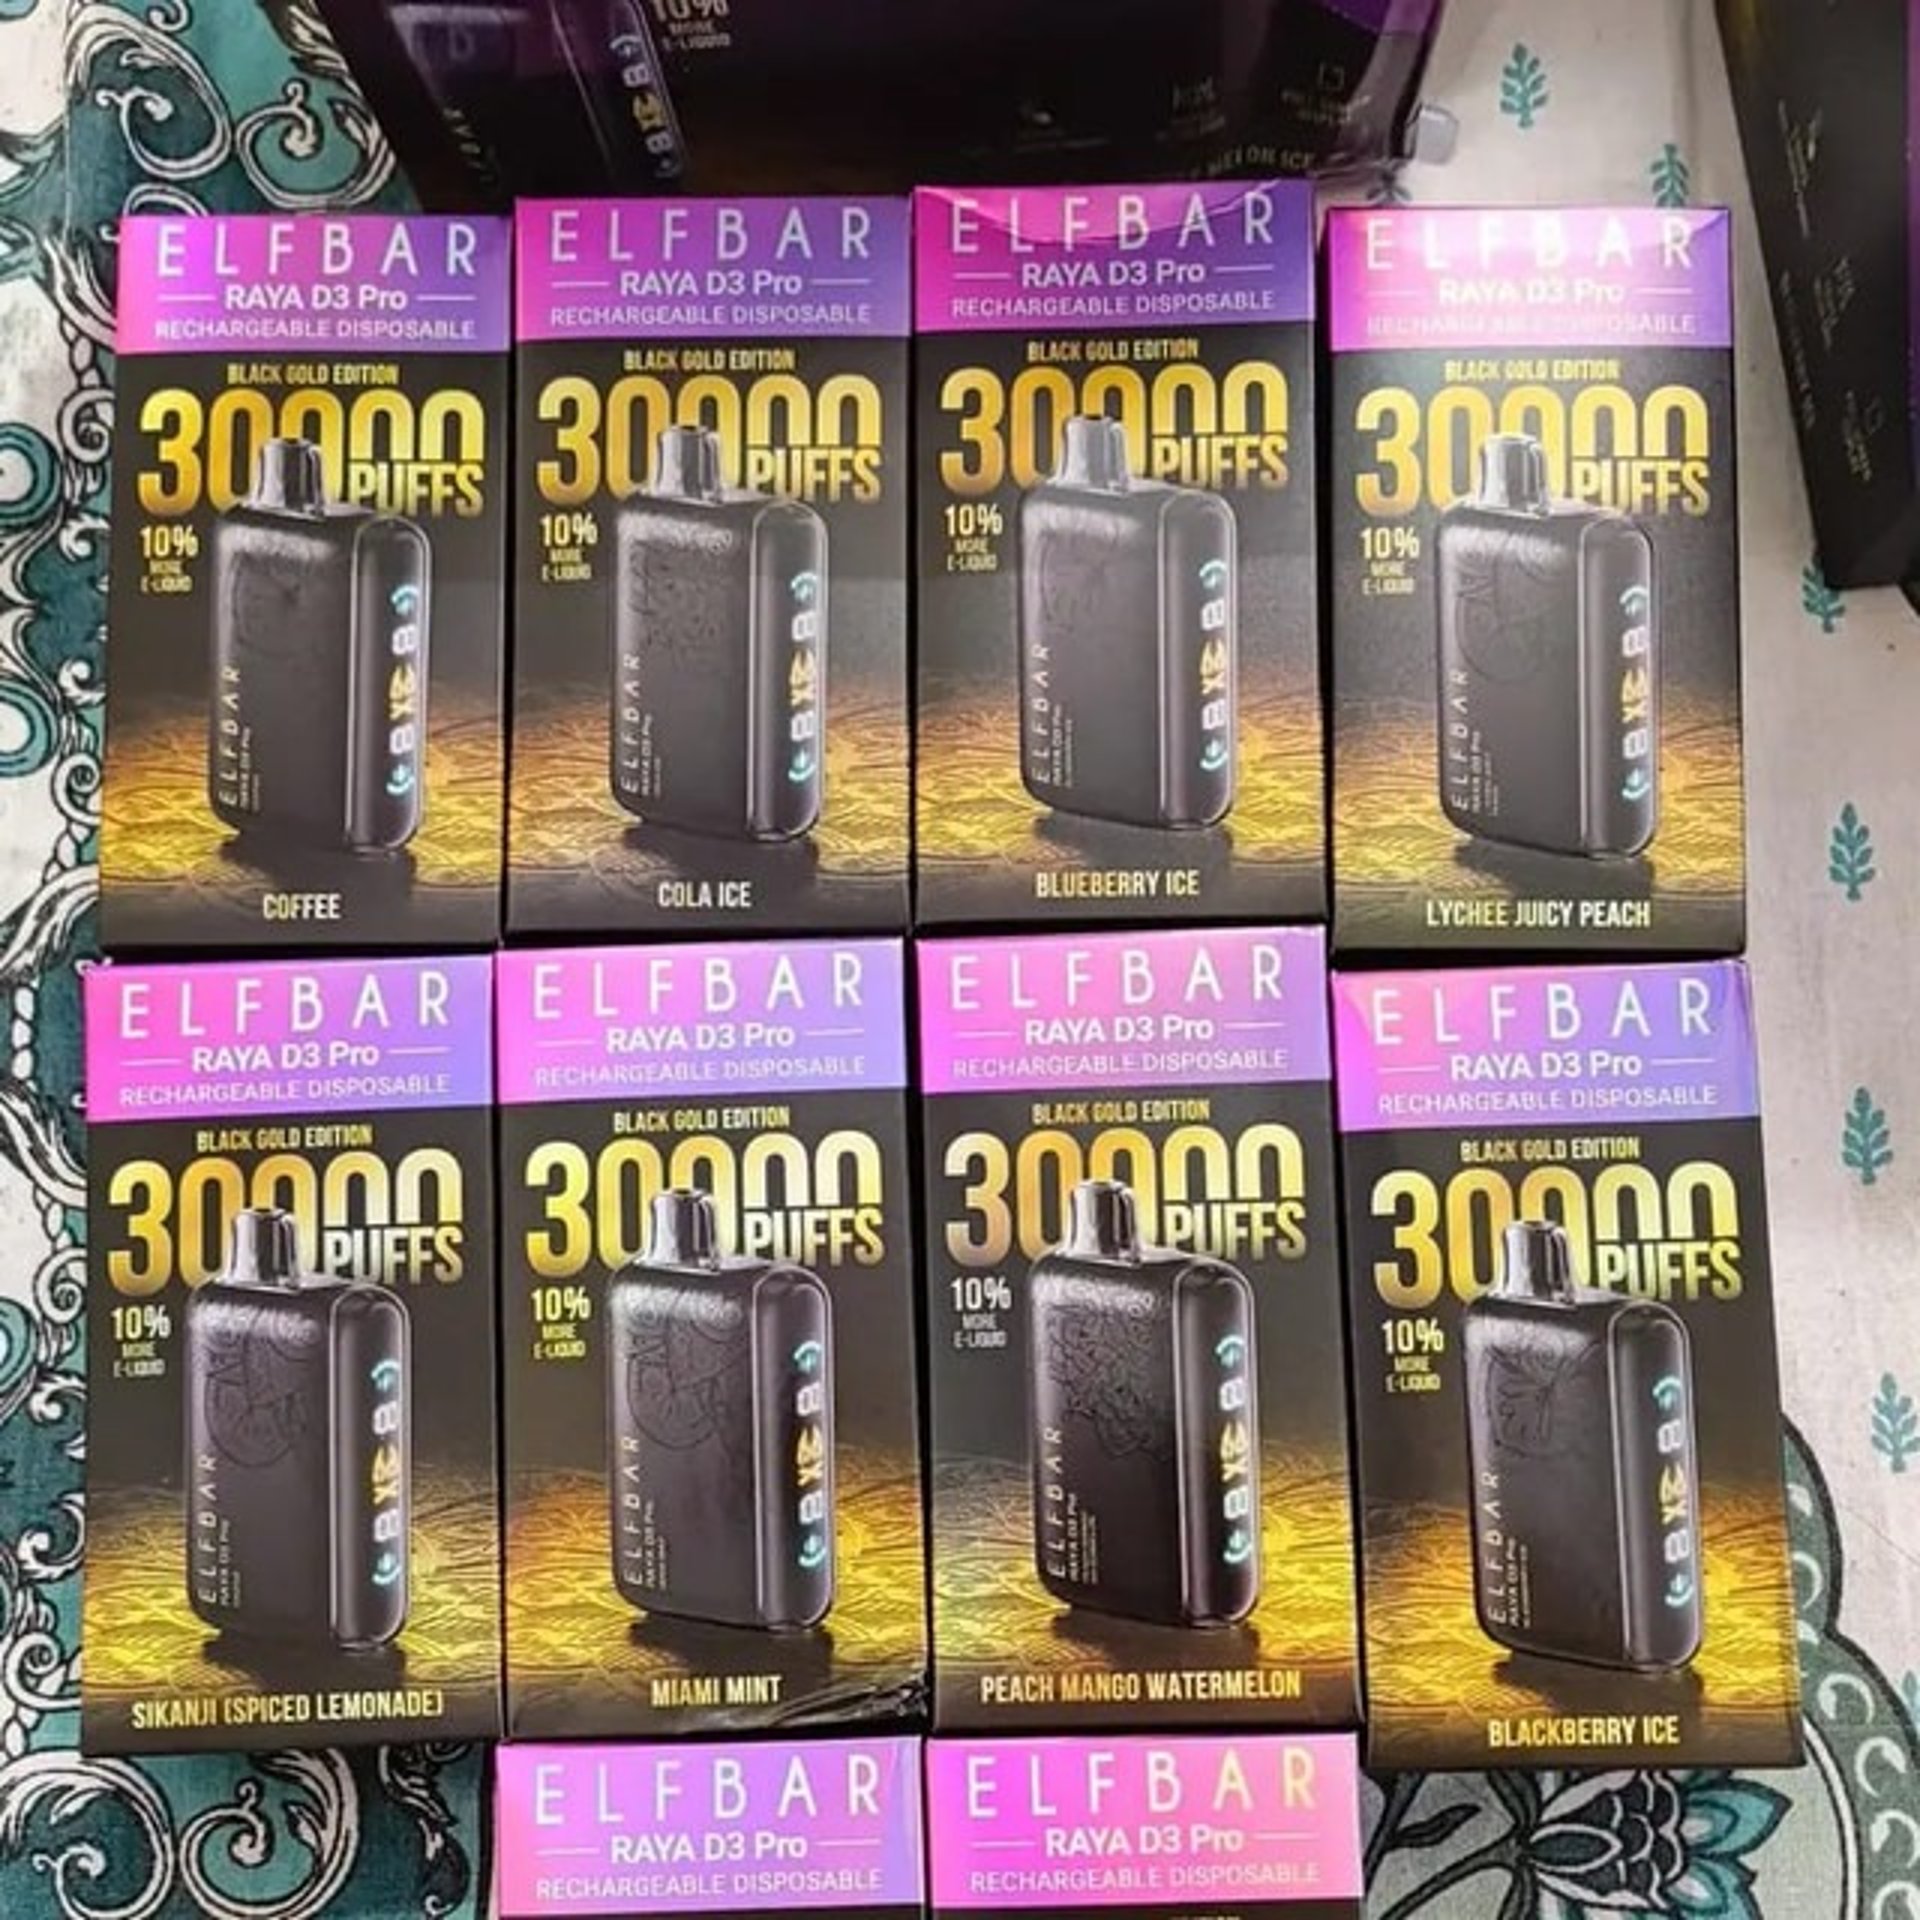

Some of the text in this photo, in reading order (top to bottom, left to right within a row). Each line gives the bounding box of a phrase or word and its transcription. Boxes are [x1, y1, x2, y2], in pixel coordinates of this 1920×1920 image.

[551, 208, 871, 262] ELFBAR
[952, 192, 1273, 253] ELFBAR
[157, 222, 478, 276] ELFBAR
[1366, 217, 1692, 271] ELFBAR
[620, 270, 801, 295] RAYA D3 Pro
[1023, 261, 1205, 288] RAYA D3 Pro
[224, 283, 407, 310] RAYA D3 Pro
[952, 291, 1274, 318] RECHARGEABLE DISPOSABLE
[1439, 279, 1624, 305] RAYA D3 Pro
[155, 319, 475, 339] RECHARGEABLE DISPOSABLE
[551, 303, 871, 326] RECHARGEABLE DISPOSABLE
[624, 350, 794, 370] BLACK GOLD EDITION
[1027, 338, 1199, 362] BLACK GOLD EDITION
[228, 365, 397, 384] BLACK GOLD EDITION
[1446, 360, 1620, 381] BLACK GOLD EDITION
[747, 448, 881, 502] PUFFS
[1153, 435, 1288, 491] PUFFS
[350, 462, 484, 518] PUFFS
[1573, 461, 1710, 518] PUFFS
[540, 513, 598, 546] 10%
[945, 504, 1002, 536] 10%
[140, 525, 198, 558] 10%
[1361, 527, 1420, 559] 10%
[658, 882, 752, 907] COLA ICE
[1036, 870, 1200, 898] BLUEBERRY ICE
[263, 894, 342, 919] COFFEE
[1427, 901, 1650, 928] LYCHEE JUICY PEACH
[534, 952, 863, 1019] ELFBAR
[951, 945, 1283, 1009] ELFBAR
[121, 971, 450, 1039] ELFBAR
[1372, 978, 1712, 1046] ELFBAR
[607, 1023, 795, 1053] RAYA D3 Pro
[1026, 1015, 1214, 1046] RAYA D3 Pro
[193, 1041, 380, 1073] RAYA D3 Pro
[536, 1056, 865, 1087] RECHARGEABLE DISPOSABLE
[953, 1049, 1288, 1079] RECHARGEABLE DISPOSABLE
[1451, 1050, 1642, 1081] RAYA D3 Pro
[120, 1074, 450, 1107] RECHARGEABLE DISPOSABLE
[1380, 1086, 1718, 1115] RECHARGEABLE DISPOSABLE
[614, 1107, 790, 1133] BLACK GOLD EDITION
[1032, 1099, 1210, 1124] BLACK GOLD EDITION
[198, 1125, 373, 1152] BLACK GOLD EDITION
[1461, 1137, 1640, 1162] BLACK GOLD EDITION
[744, 1208, 885, 1269] PUFFS
[1163, 1200, 1307, 1262] PUFFS
[323, 1226, 464, 1285] PUFFS
[1597, 1240, 1742, 1300] PUFFS
[531, 1287, 590, 1322] 10%
[951, 1278, 1011, 1311] 10%
[112, 1306, 171, 1341] 10%
[1382, 1319, 1443, 1354] 10%
[651, 1675, 782, 1707] MIAMI MINT
[980, 1670, 1301, 1702] PEACH MANGO WATERMELON
[132, 1701, 217, 1729] SIKANJI
[1488, 1715, 1680, 1746] BLACKBERRY ICE
[534, 1756, 881, 1826] ELFBAR
[967, 1744, 1316, 1820] ELFBAR
[611, 1829, 809, 1864] RAYA D3 Pro
[1046, 1825, 1245, 1857] RAYA D3 Pro
[535, 1869, 883, 1901] RECHARGEABLE DISPOSABLE
[970, 1861, 1322, 1895] RECHARGEABLE DISPOSABLE
